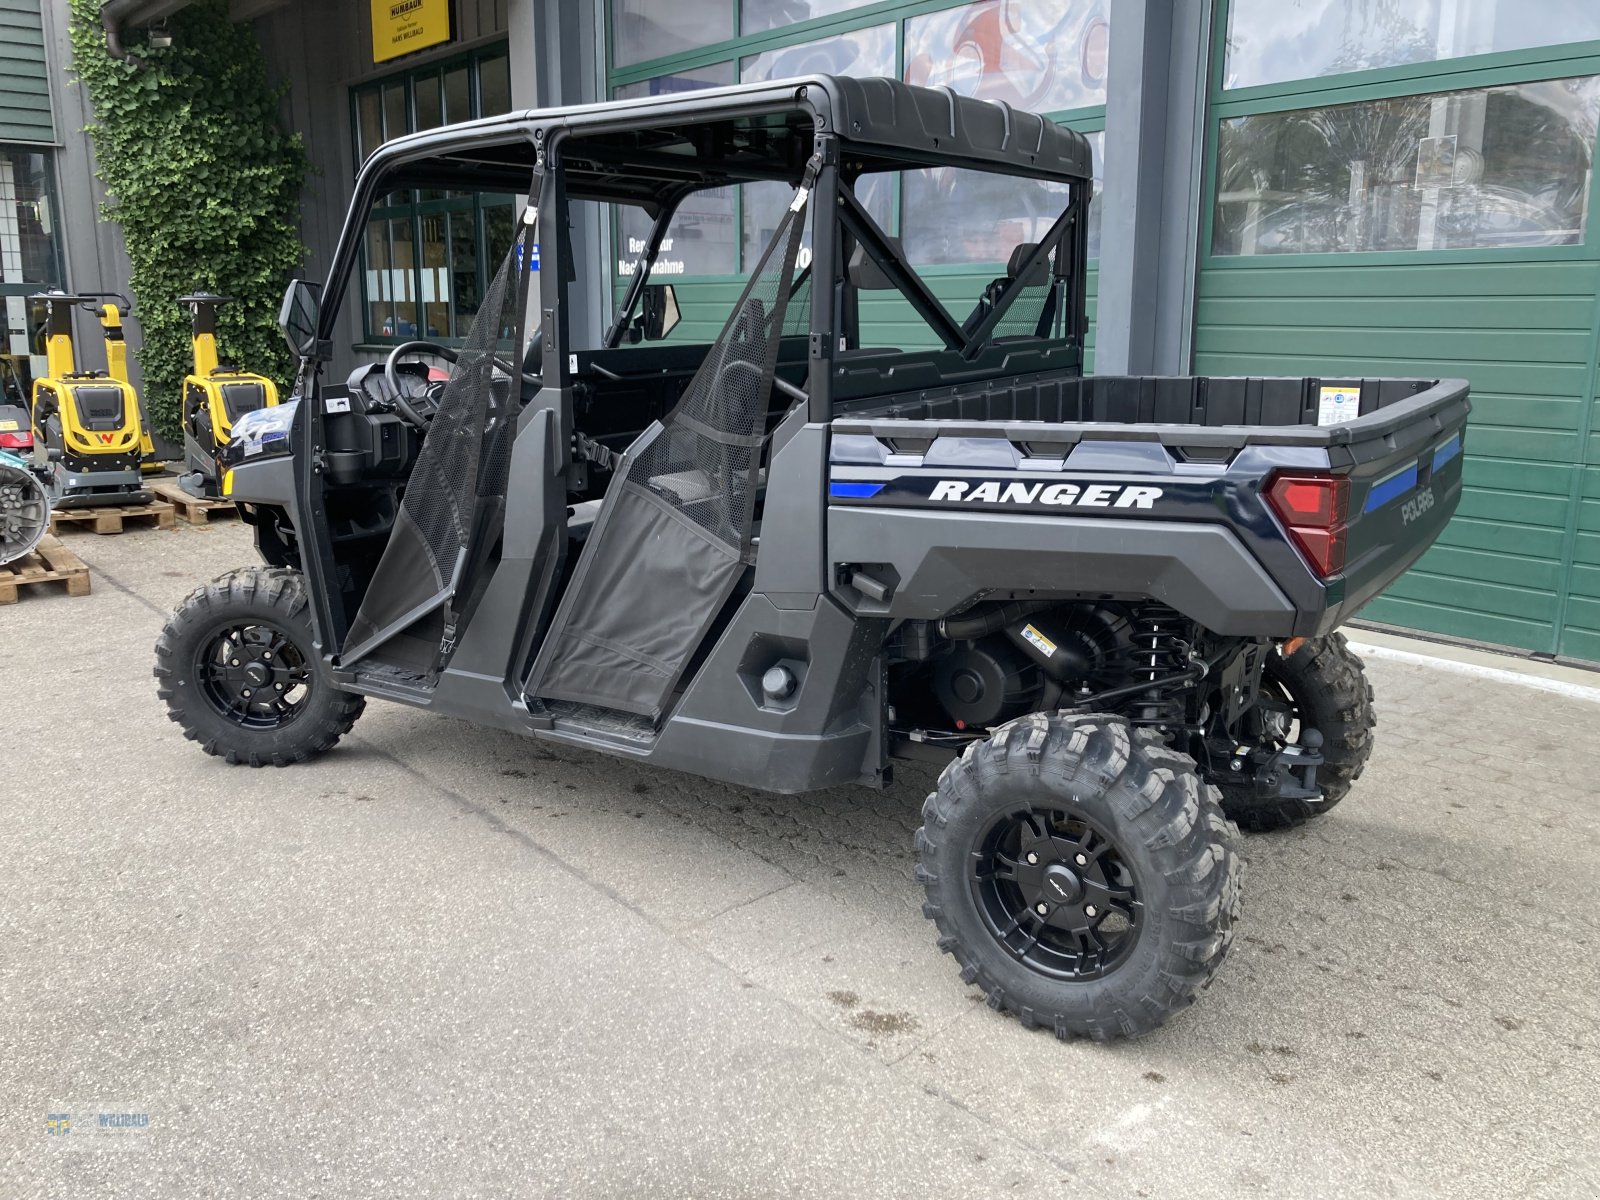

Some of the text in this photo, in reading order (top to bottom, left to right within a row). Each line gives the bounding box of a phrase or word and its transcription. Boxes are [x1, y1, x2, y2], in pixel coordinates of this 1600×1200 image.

[391, 0, 422, 17] HUMBAUR
[928, 480, 1163, 509] RANGER
[1401, 487, 1435, 526] POLARIS
